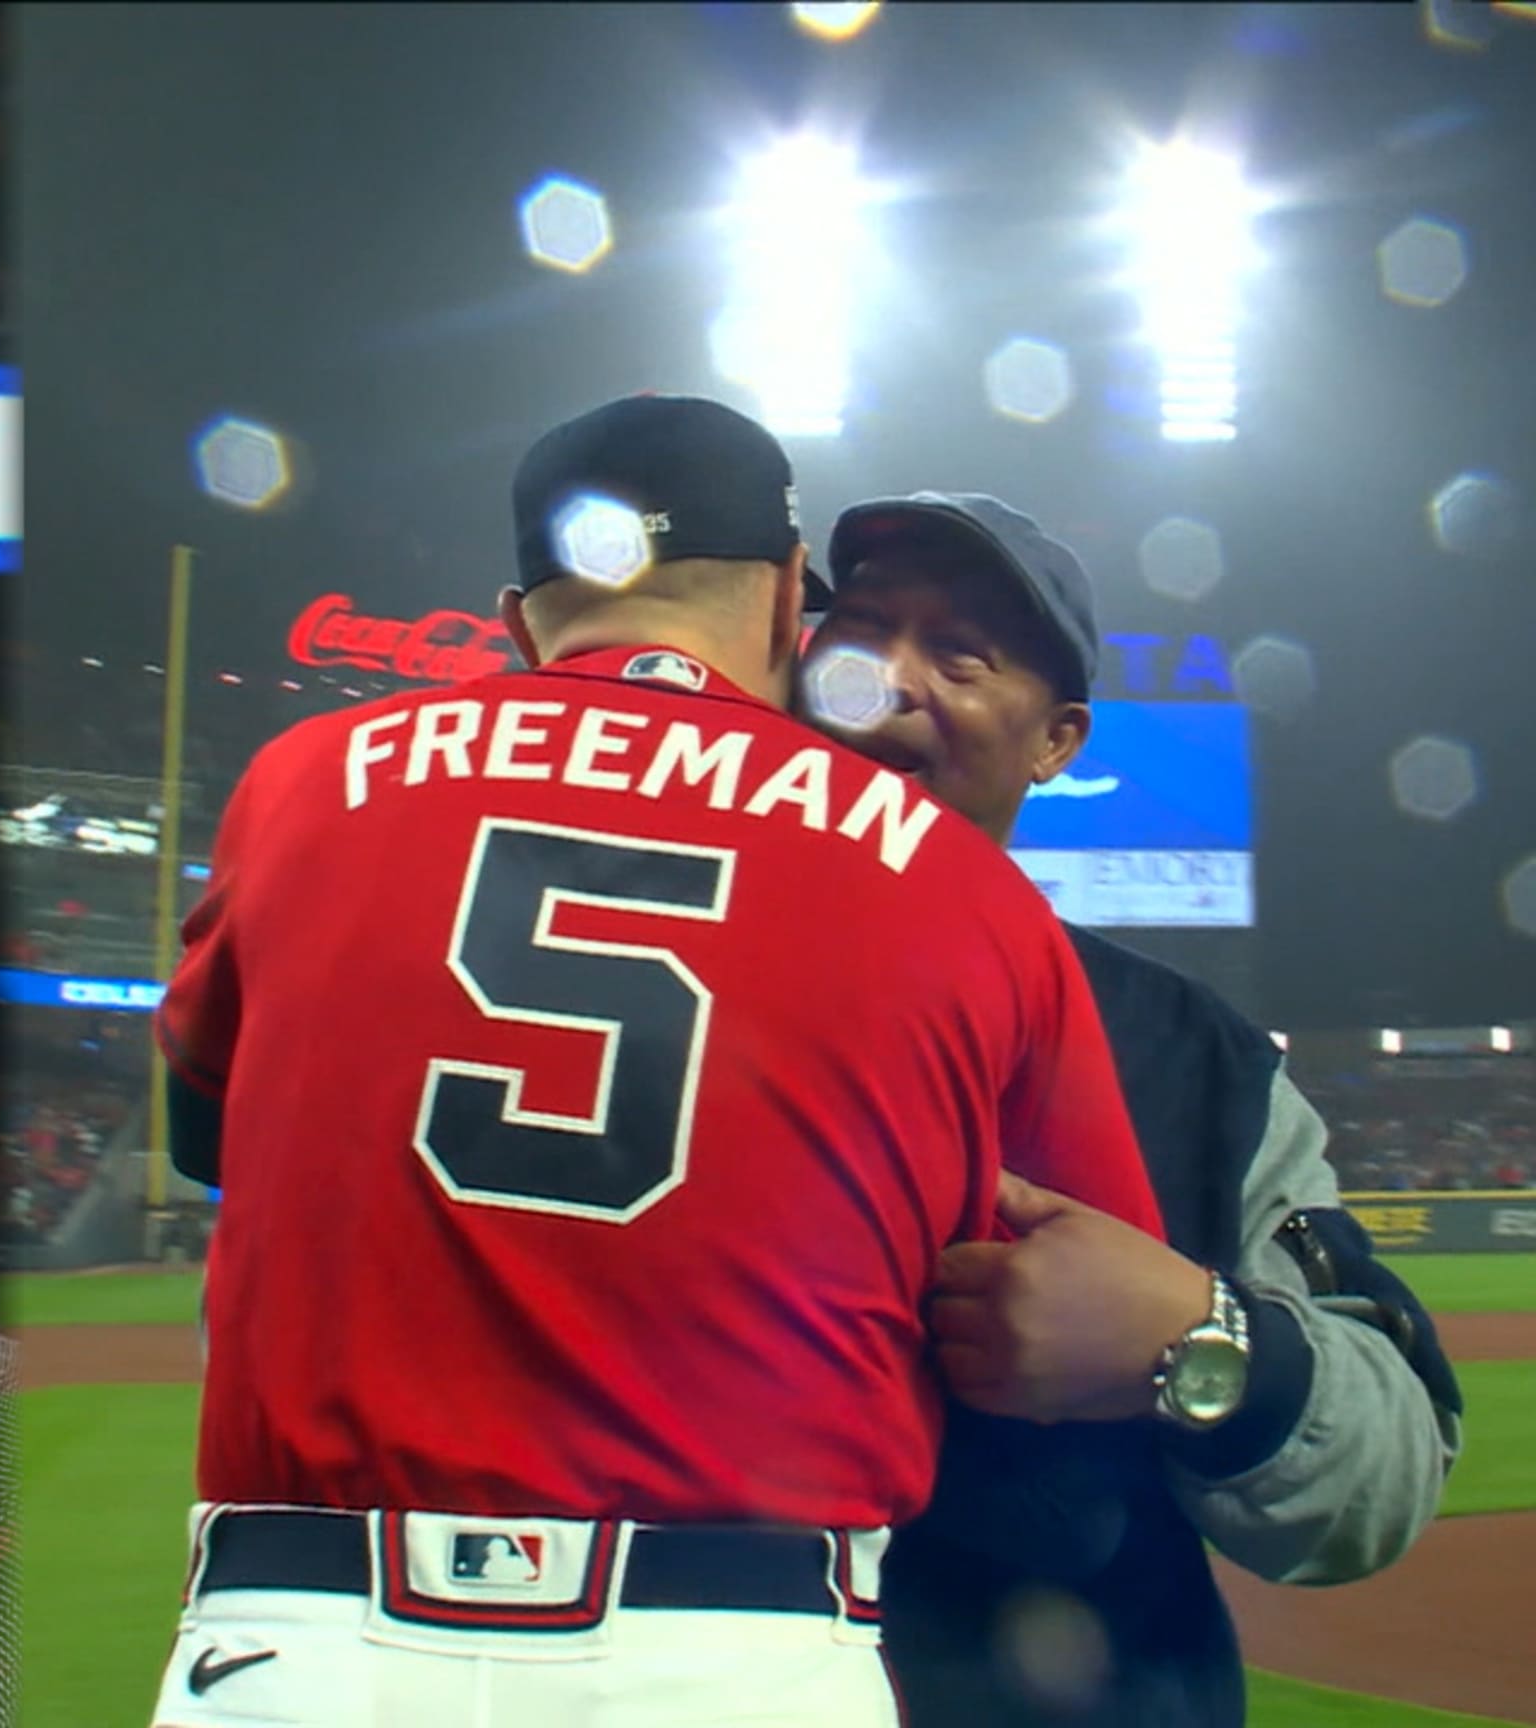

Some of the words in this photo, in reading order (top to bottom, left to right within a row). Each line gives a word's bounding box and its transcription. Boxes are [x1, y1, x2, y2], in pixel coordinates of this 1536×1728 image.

[1102, 632, 1234, 693] TA
[346, 700, 941, 874] FREEMAN
[414, 817, 737, 1224] 5
